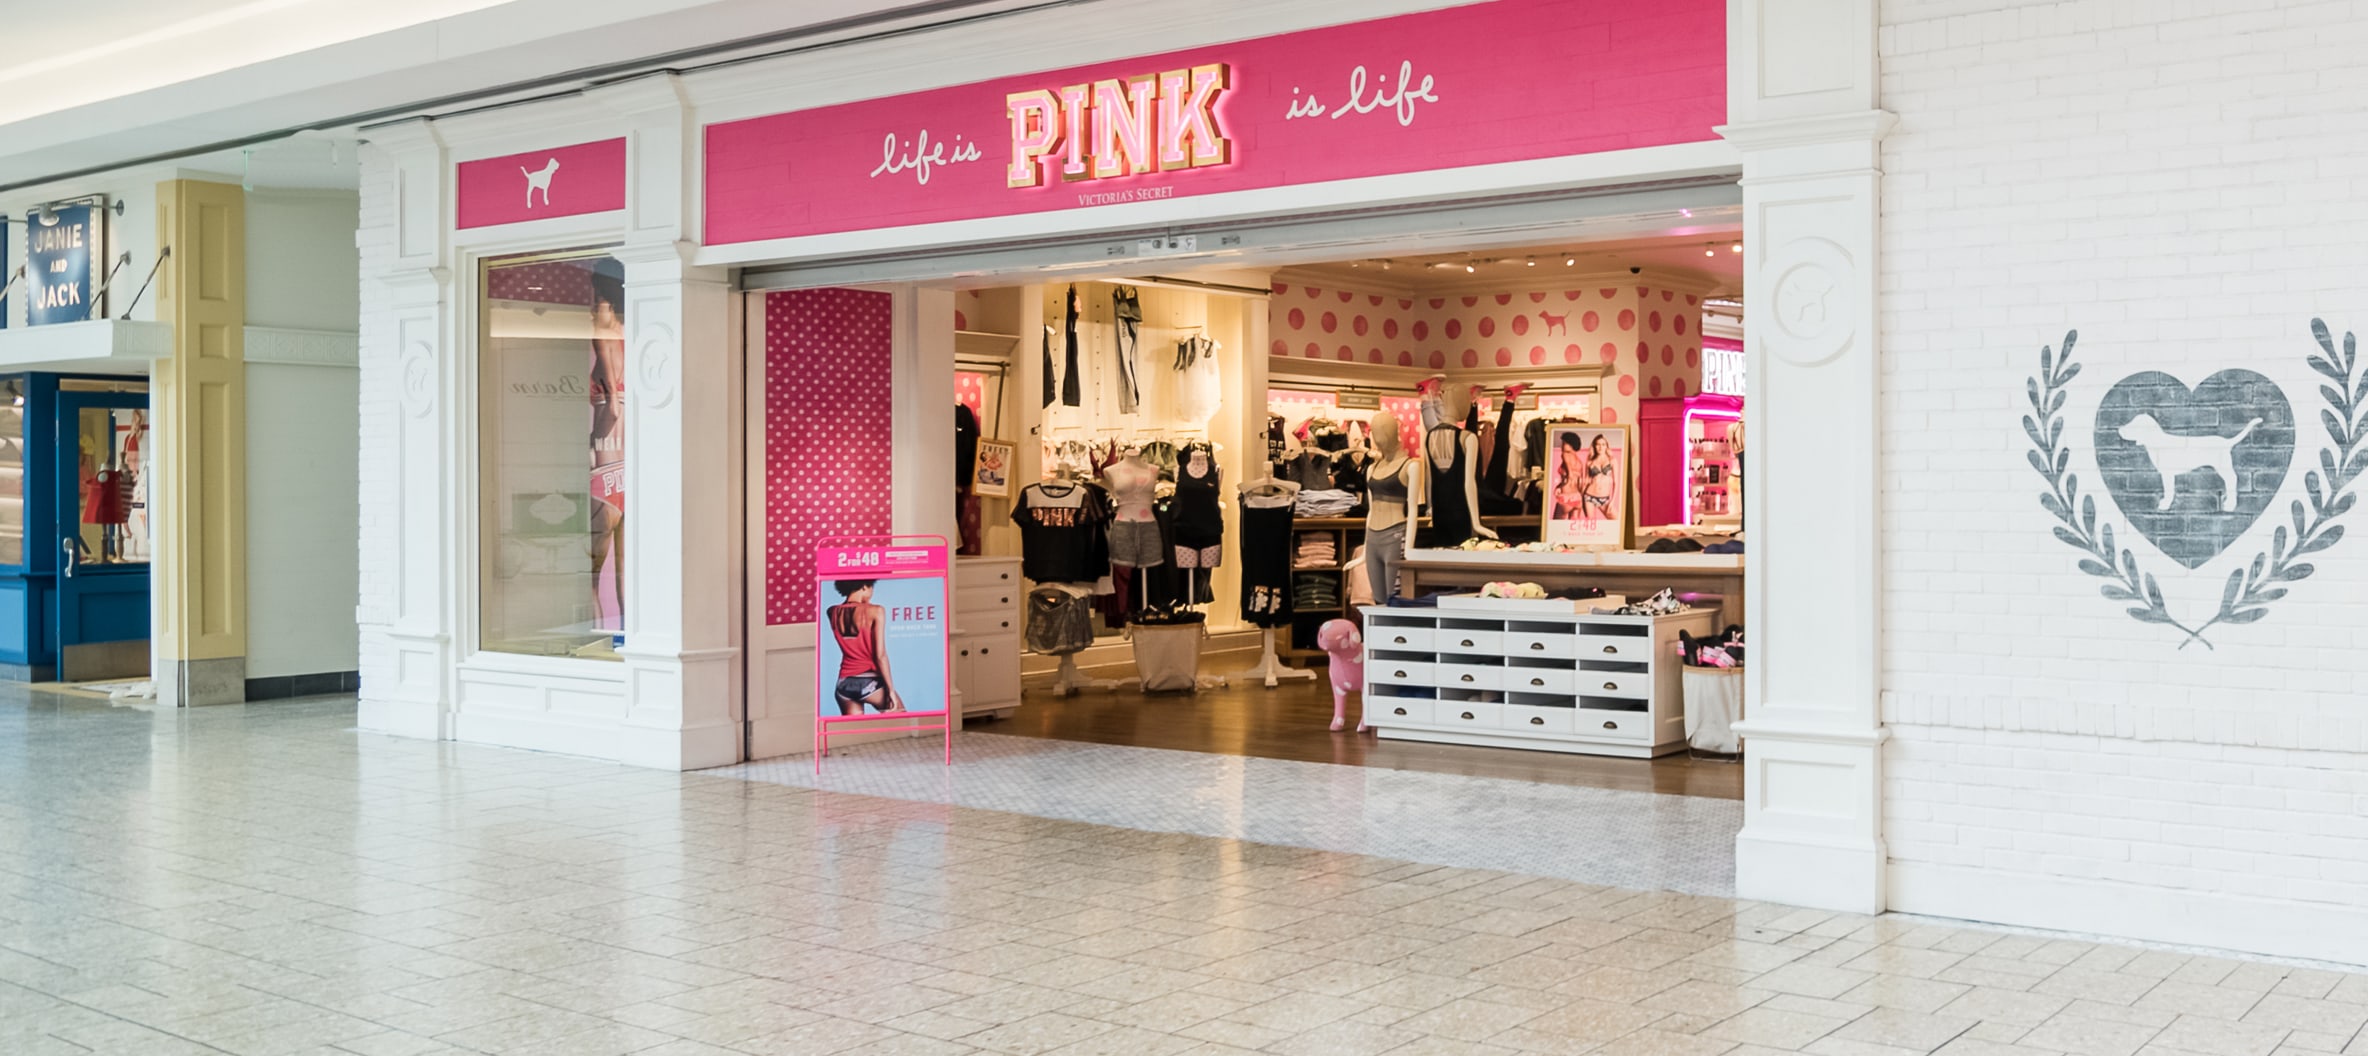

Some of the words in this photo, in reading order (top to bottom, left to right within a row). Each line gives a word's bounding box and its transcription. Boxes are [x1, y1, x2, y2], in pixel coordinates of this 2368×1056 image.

[870, 129, 947, 185] life
[950, 134, 982, 163] is
[1006, 63, 1231, 188] PINK
[1285, 87, 1326, 120] is
[1331, 60, 1439, 126] life
[1078, 190, 1134, 206] VICTORIA'S
[1136, 186, 1174, 200] SECRET
[36, 224, 82, 253] JANIE
[51, 259, 68, 273] AND
[37, 282, 80, 309] JACK
[892, 606, 935, 621] FREE
